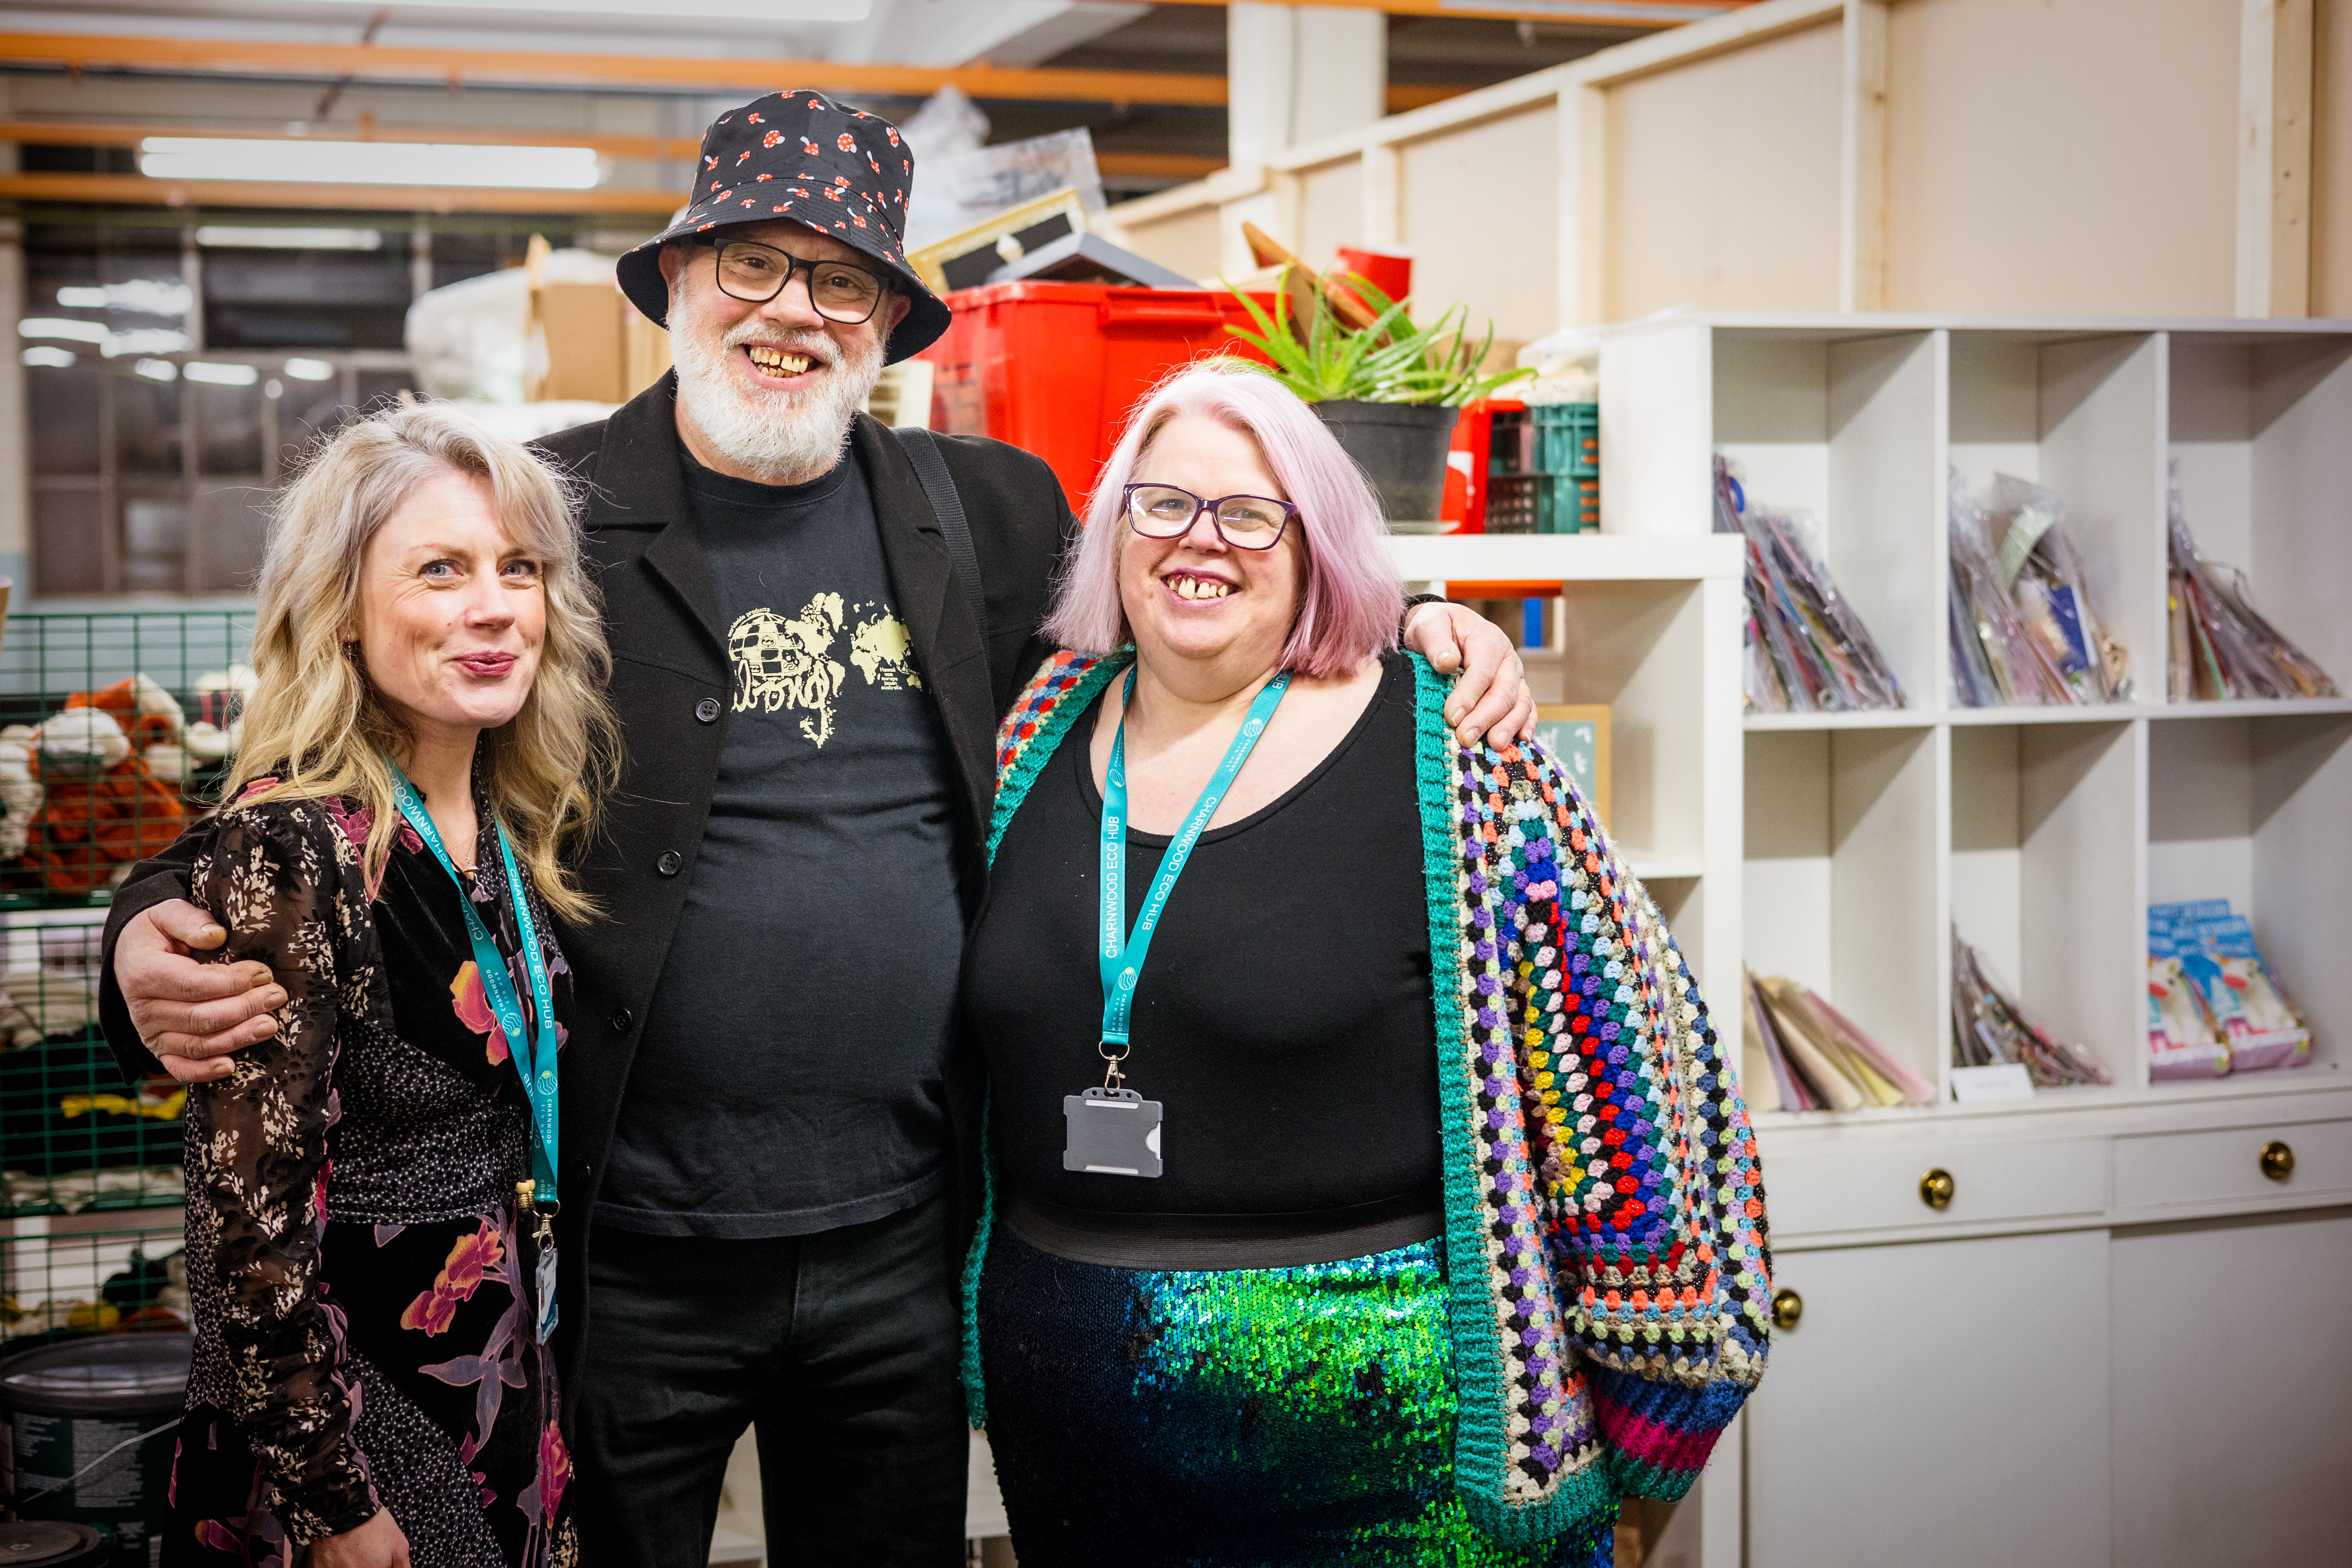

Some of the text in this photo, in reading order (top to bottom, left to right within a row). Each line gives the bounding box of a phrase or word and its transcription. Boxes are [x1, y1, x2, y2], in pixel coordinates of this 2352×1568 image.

[728, 607, 771, 637] worldwide products
[1114, 734, 1122, 767] CHARNWOOD
[1226, 742, 1243, 767] ECO HUB
[1229, 739, 1252, 772] CHARNWOOD
[391, 778, 447, 862] CHARNWOOD
[1142, 796, 1217, 931] CHARNWOOD ECO HUB
[1106, 816, 1120, 959] CHARNWOOD ECO HUB
[510, 868, 552, 1029] CHARNWOOD ECO HUB
[486, 969, 506, 1012] CHARNWOOD
[494, 972, 503, 986] HUB
